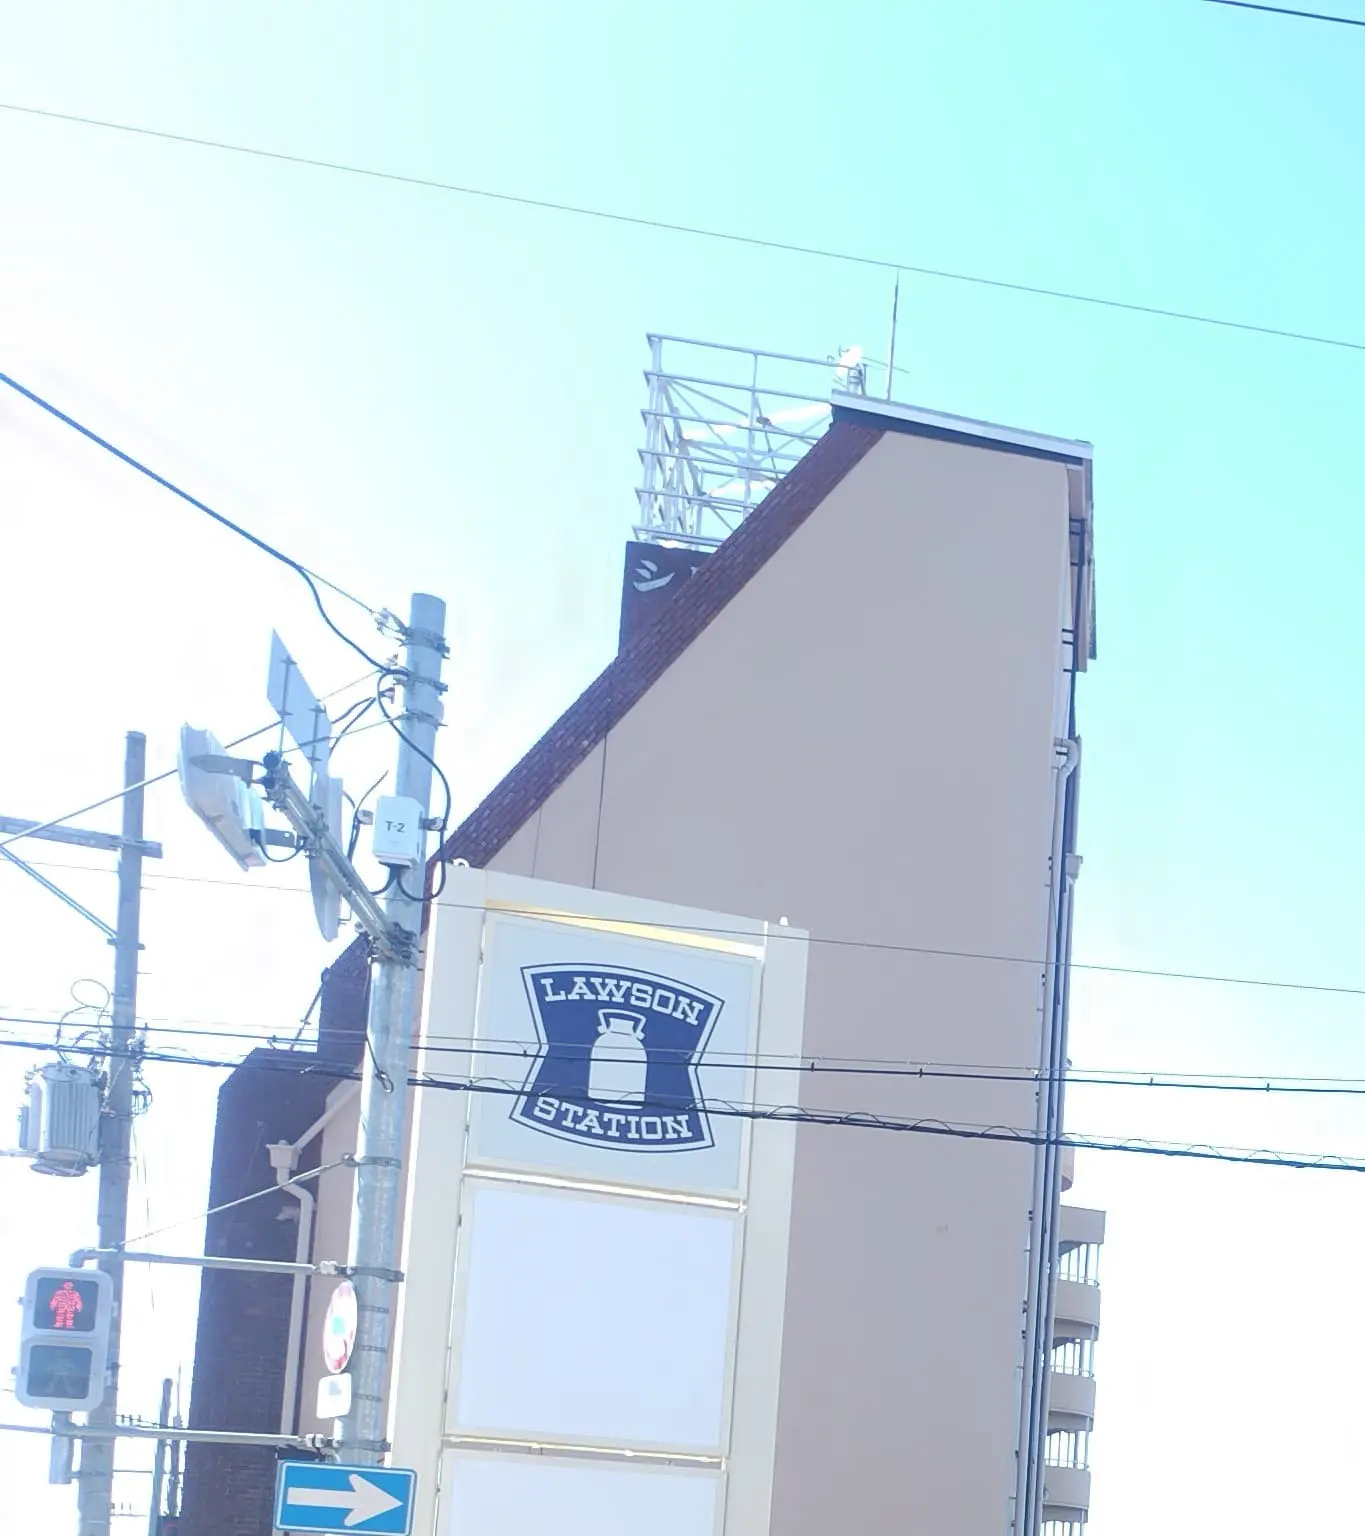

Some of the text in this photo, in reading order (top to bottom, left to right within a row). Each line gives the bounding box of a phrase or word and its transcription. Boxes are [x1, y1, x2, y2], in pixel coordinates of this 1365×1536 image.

[385, 820, 405, 833] T-2
[540, 976, 704, 1026] LAWSON
[533, 1096, 692, 1139] STATION
